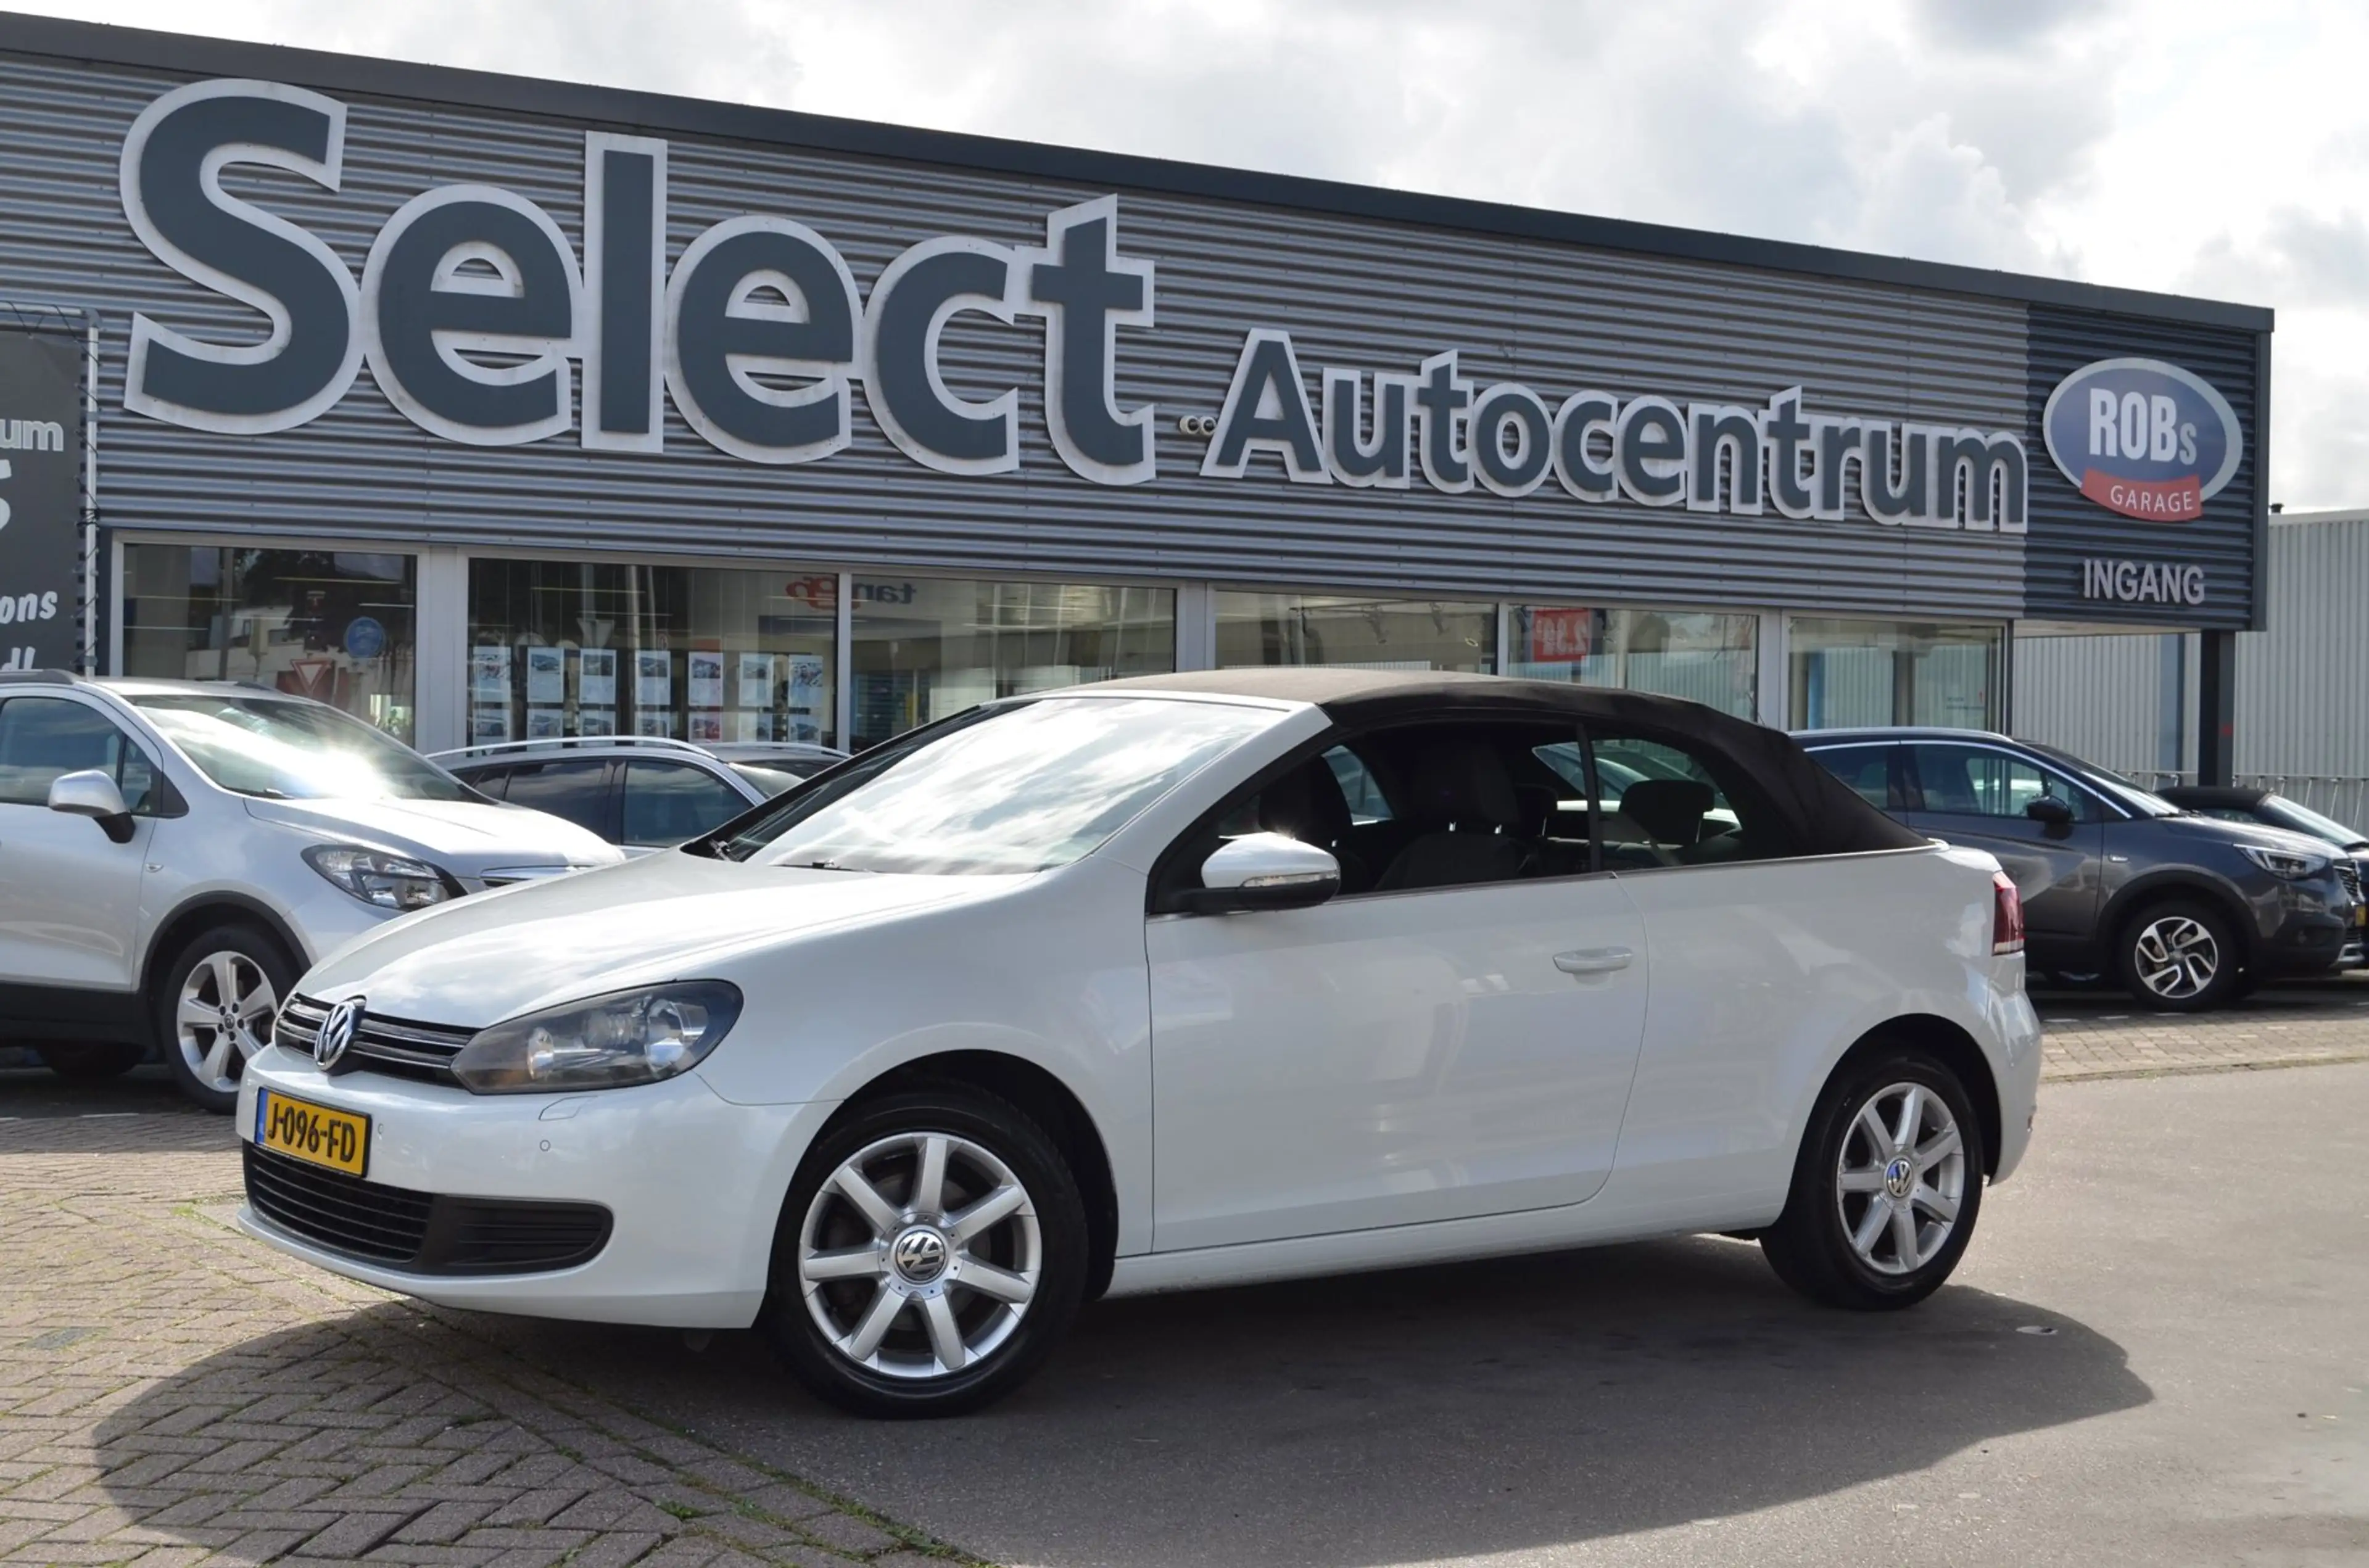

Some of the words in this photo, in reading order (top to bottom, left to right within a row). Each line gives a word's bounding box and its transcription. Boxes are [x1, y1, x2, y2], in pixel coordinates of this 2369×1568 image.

[120, 78, 1156, 485] Select
[1199, 328, 2028, 533] Autocentrum
[2111, 485, 2194, 513] GARAGE
[2084, 559, 2205, 605] INGANG
[267, 1102, 356, 1163] J-096-FD
